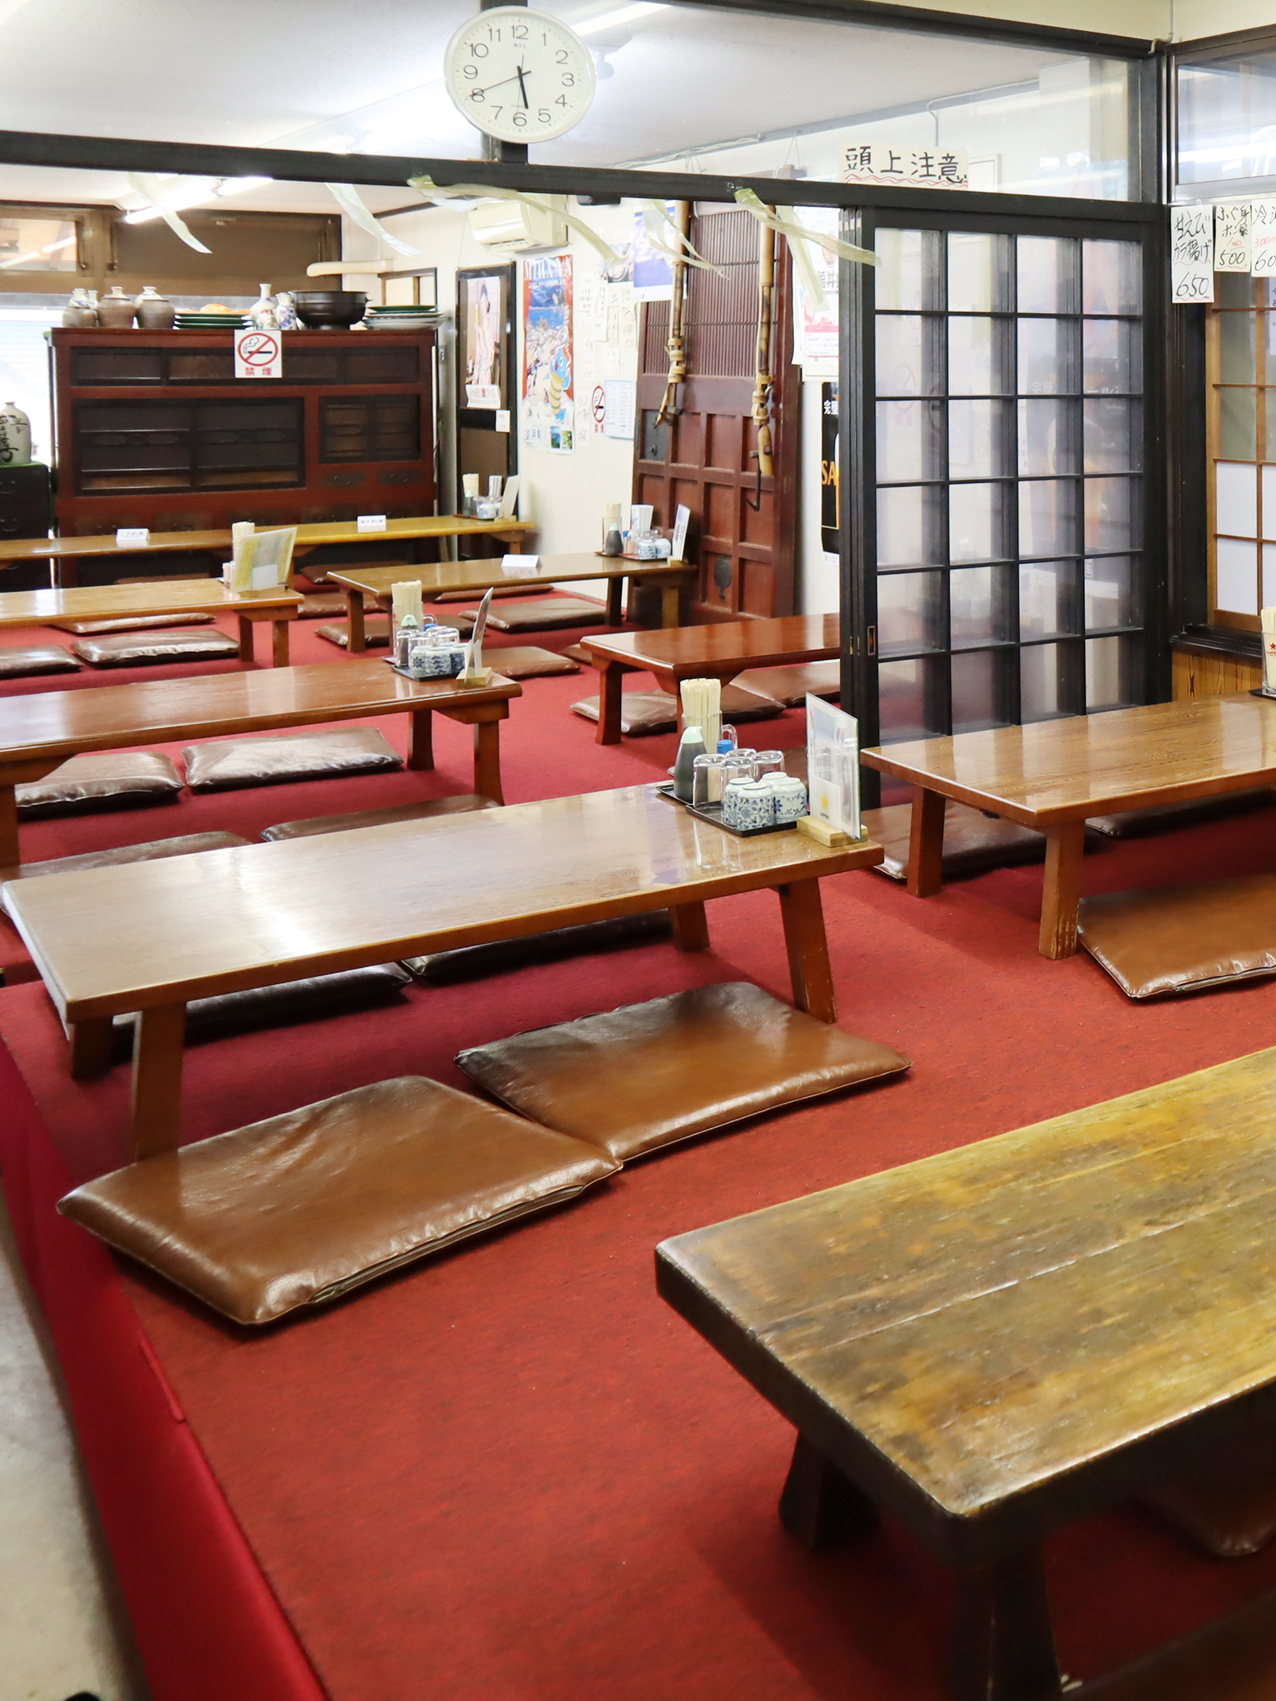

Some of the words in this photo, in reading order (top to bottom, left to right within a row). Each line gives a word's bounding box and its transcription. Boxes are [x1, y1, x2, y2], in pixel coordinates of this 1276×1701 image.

[488, 27, 501, 42] 11
[511, 24, 529, 40] 12
[541, 32, 547, 46] 1
[469, 43, 489, 58] 10
[555, 50, 568, 64] 2
[463, 65, 478, 80] 9
[561, 72, 575, 87] 3
[471, 87, 485, 103] 8
[555, 94, 568, 108] 4
[490, 105, 503, 120] 7
[512, 111, 527, 127] 6
[538, 108, 551, 123] 5
[844, 146, 967, 183] 頭上注意
